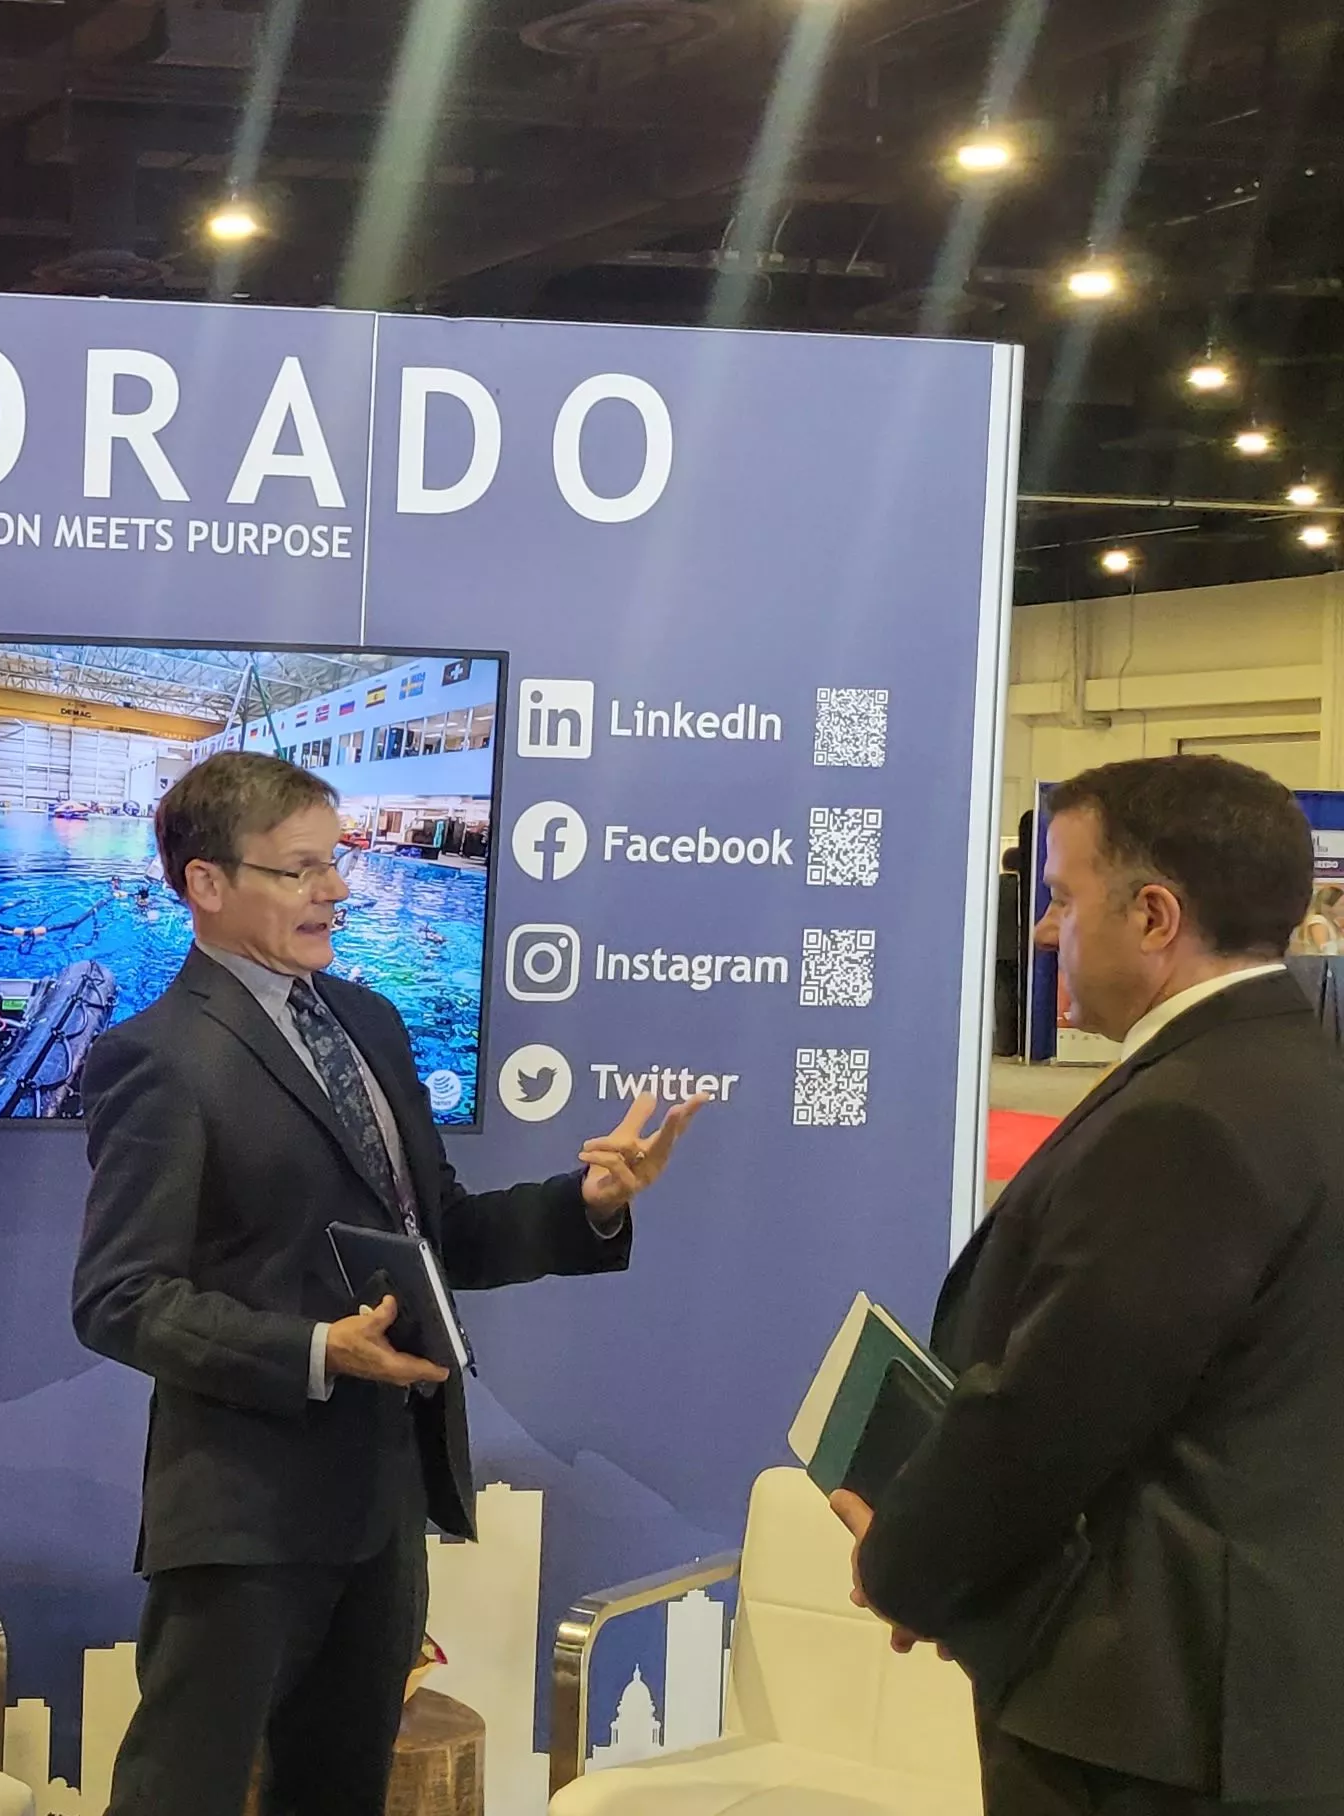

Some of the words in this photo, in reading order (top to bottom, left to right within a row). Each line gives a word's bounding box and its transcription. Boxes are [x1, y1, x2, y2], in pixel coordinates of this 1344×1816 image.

[53, 514, 174, 552] MEETS
[188, 520, 353, 559] PURPOSE
[60, 708, 92, 718] DEMAG
[610, 700, 783, 741] LinkedIn
[604, 826, 794, 866] Facebook
[595, 944, 790, 991] Instagram
[591, 1063, 739, 1102] Twitter
